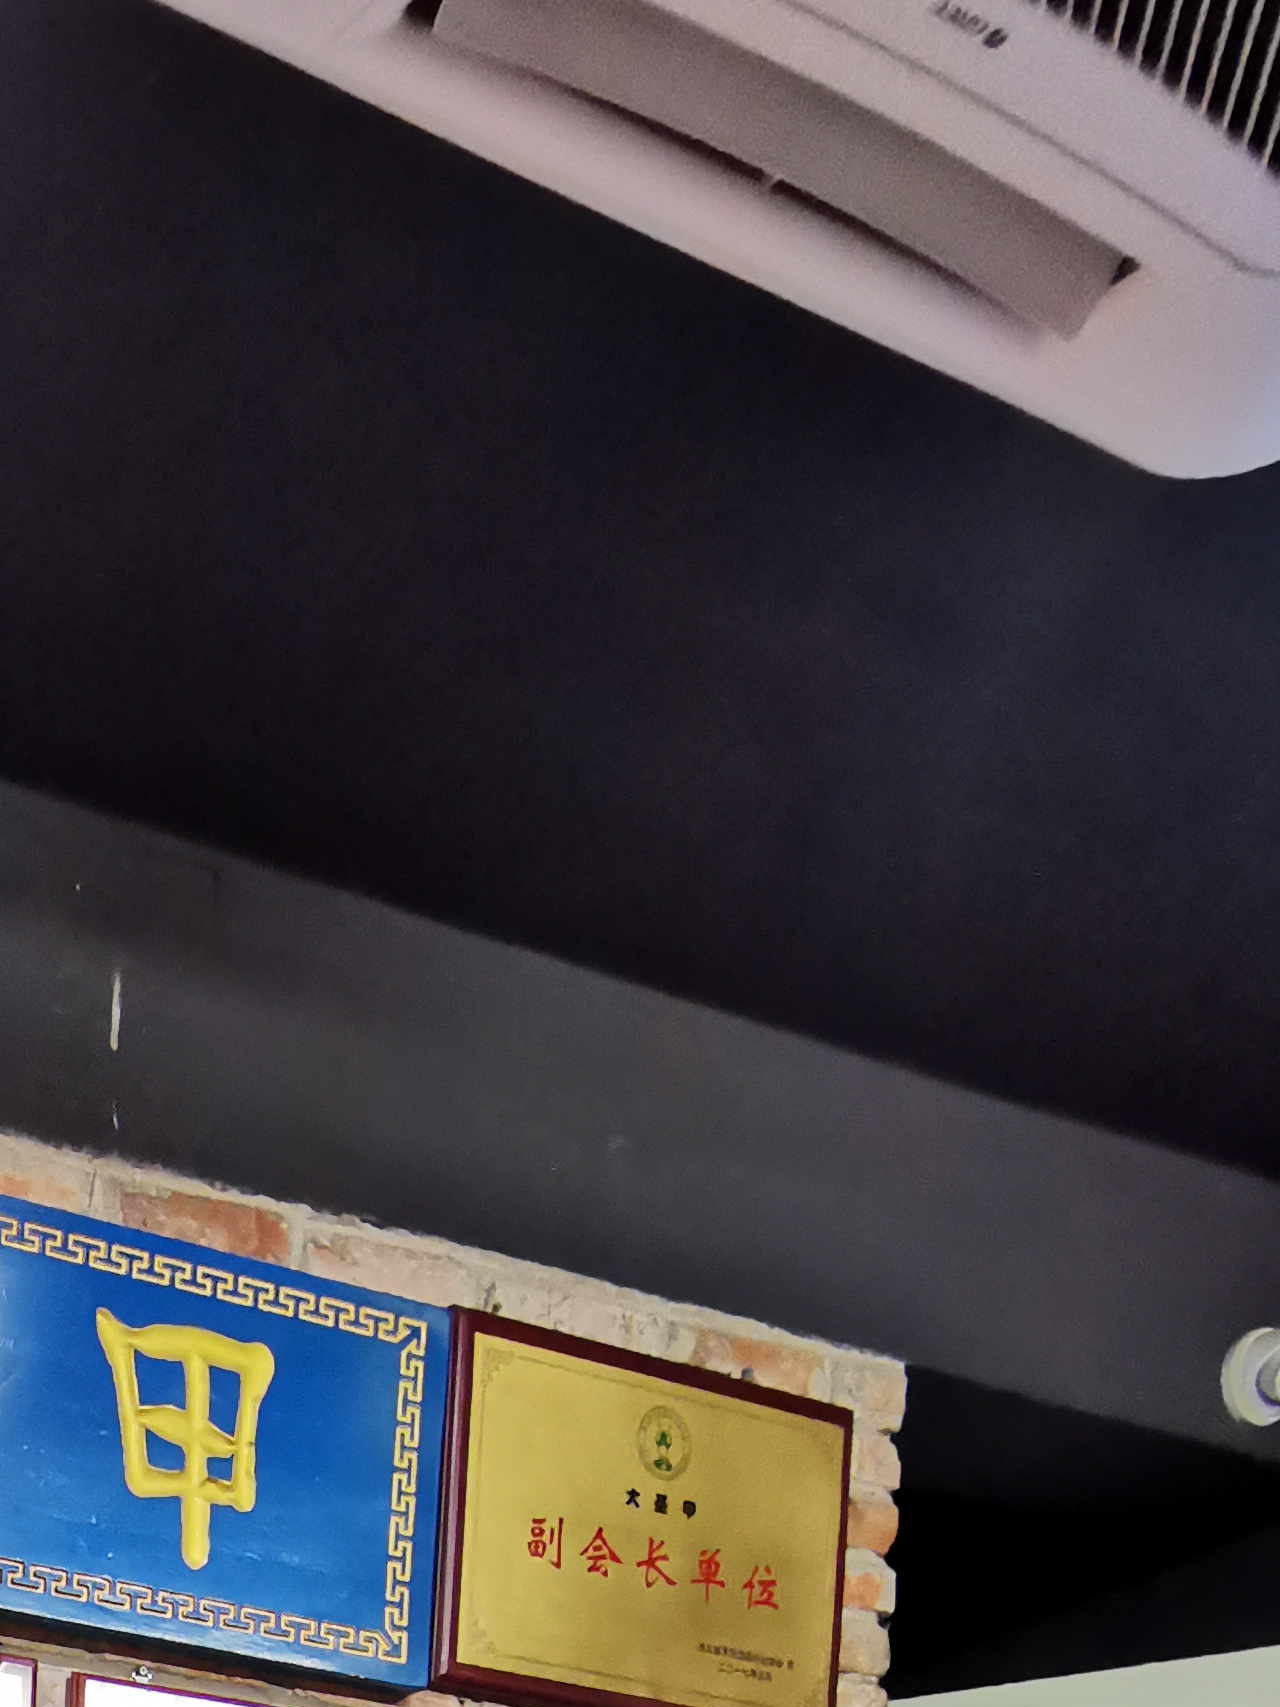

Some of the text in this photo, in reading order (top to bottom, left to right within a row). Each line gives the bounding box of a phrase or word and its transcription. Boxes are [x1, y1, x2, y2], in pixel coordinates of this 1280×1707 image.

[527, 1517, 779, 1610] 副会长单位
